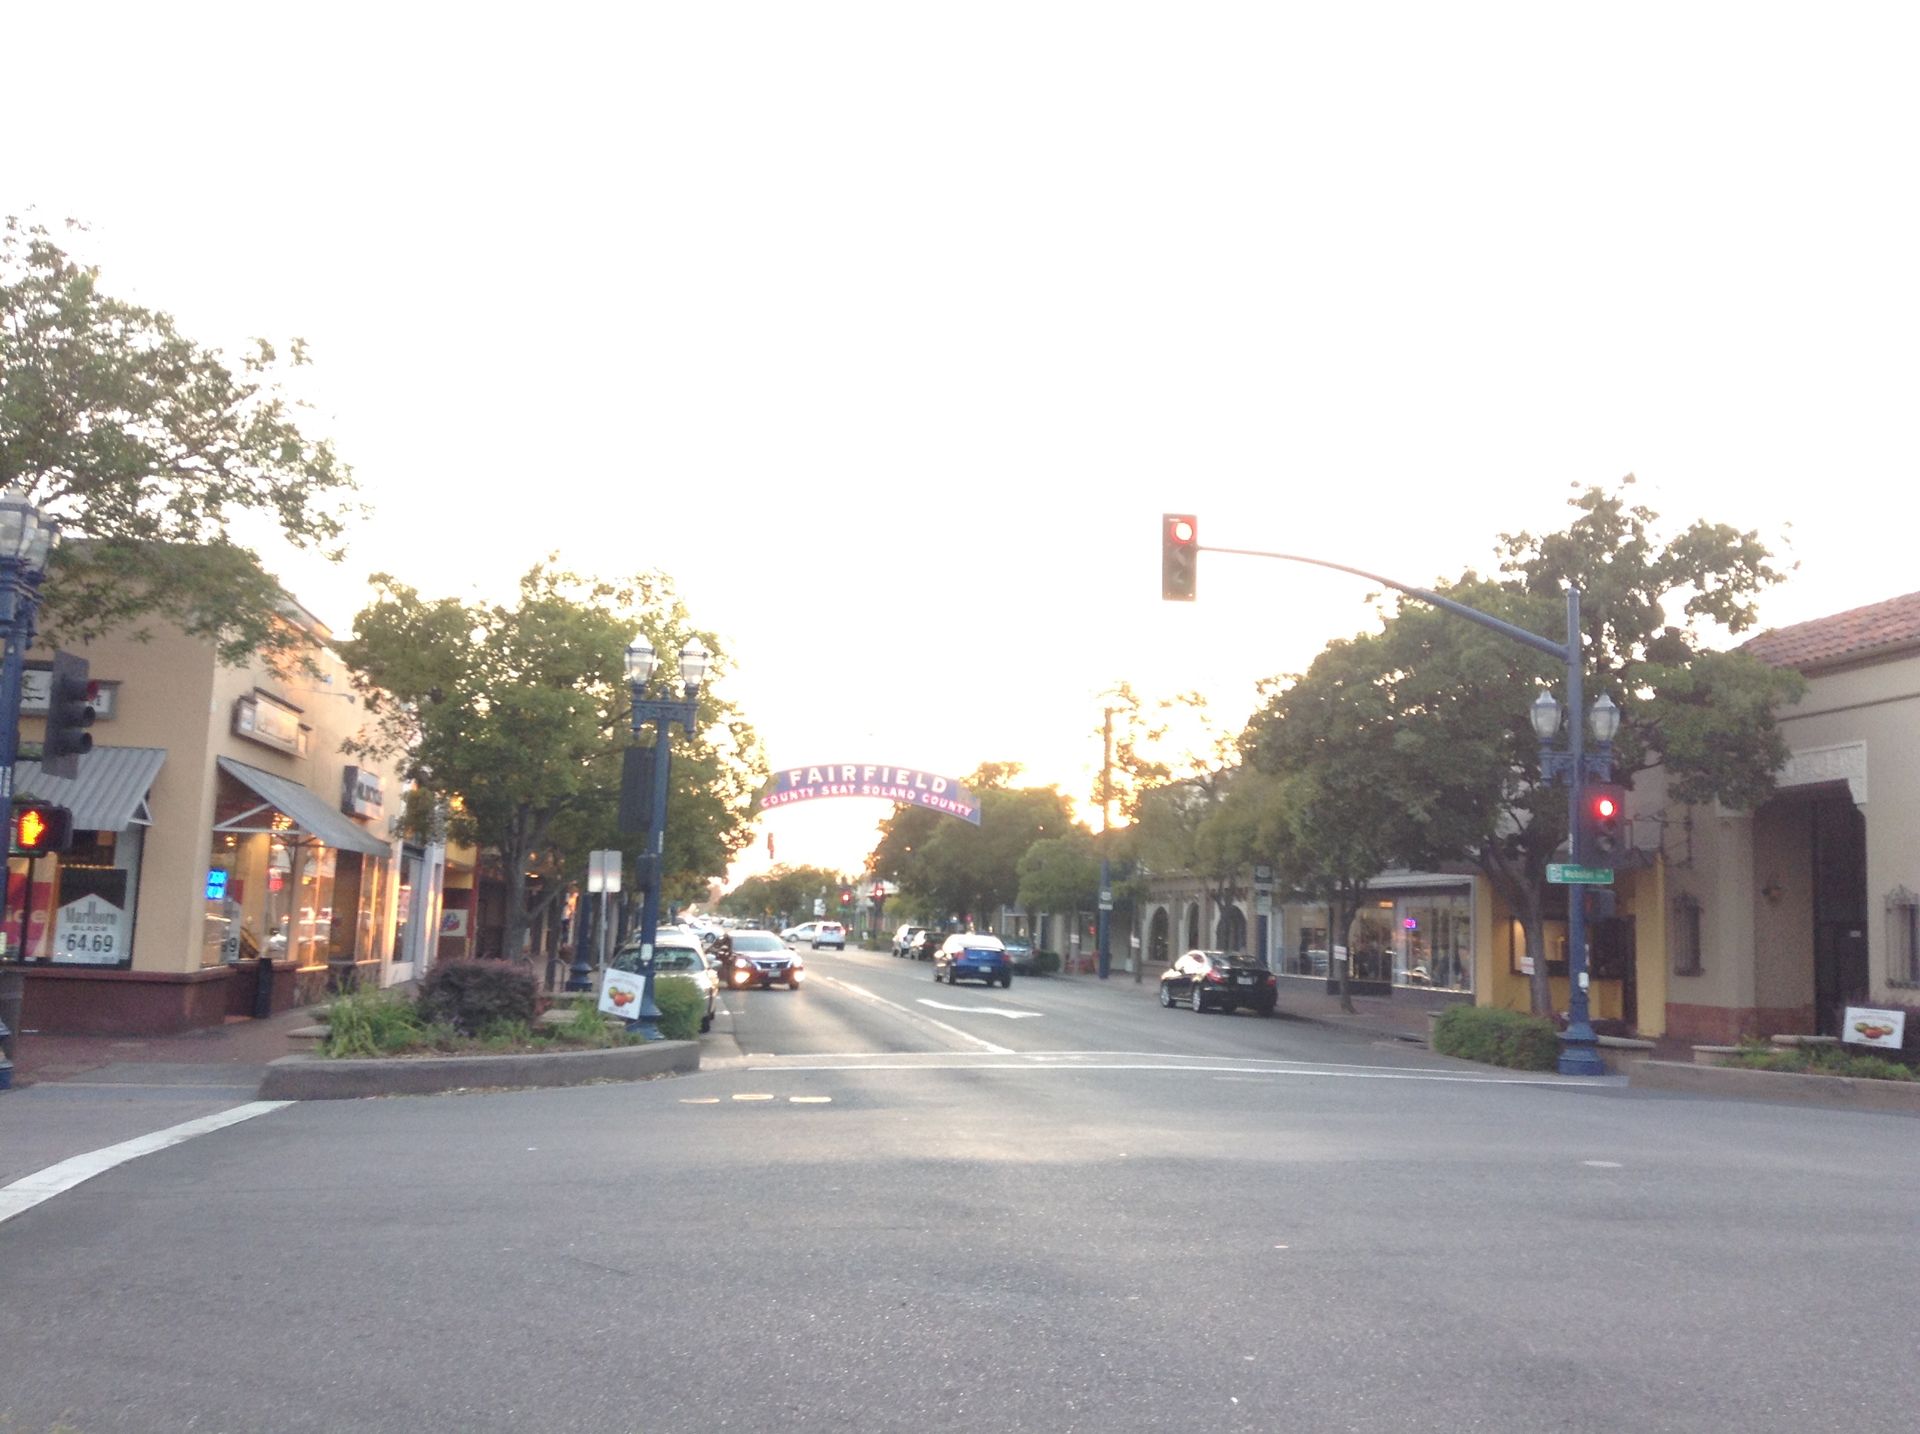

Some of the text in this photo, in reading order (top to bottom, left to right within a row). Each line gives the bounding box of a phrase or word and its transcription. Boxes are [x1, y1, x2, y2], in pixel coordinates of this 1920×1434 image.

[788, 765, 948, 793] FAIRFIELD
[760, 784, 973, 817] COUNTY SEAT SOLANO COUNTY
[65, 901, 118, 925] Marlboro
